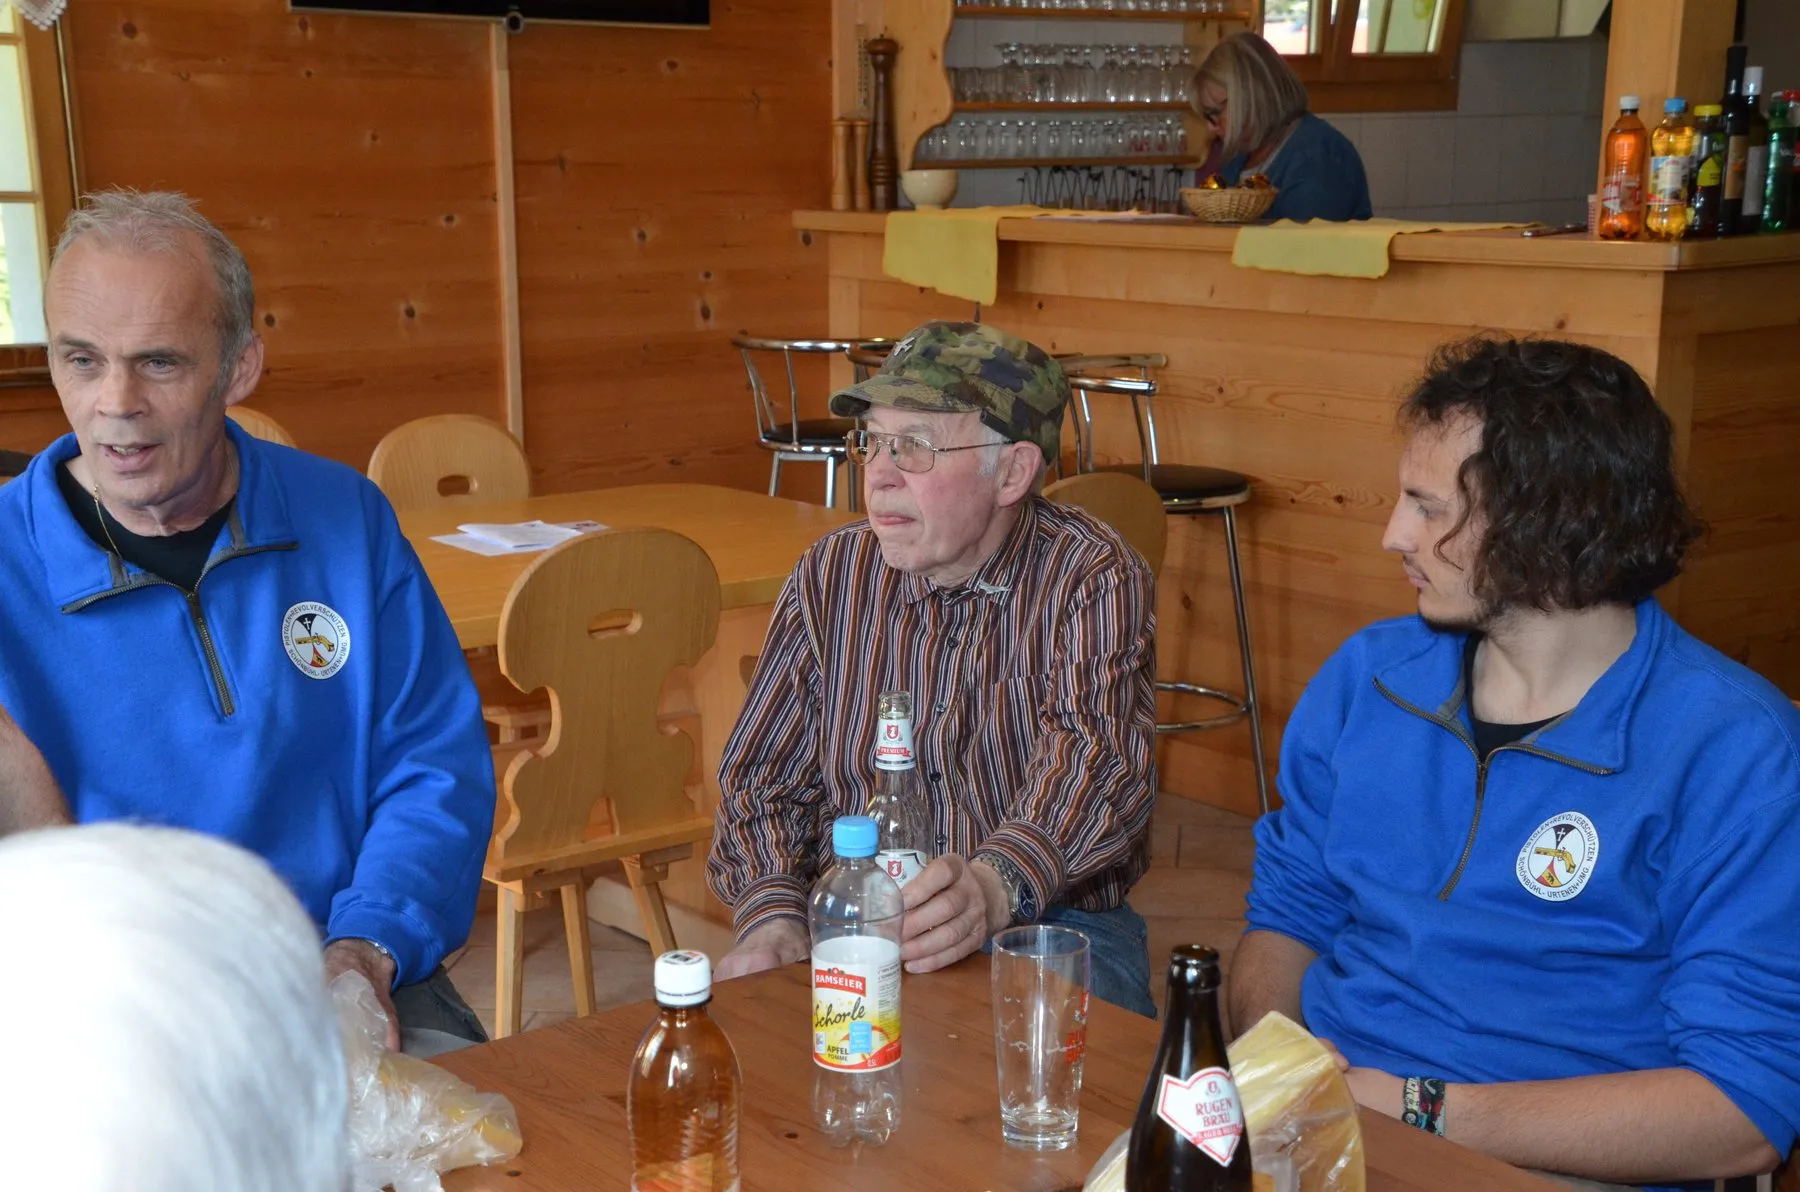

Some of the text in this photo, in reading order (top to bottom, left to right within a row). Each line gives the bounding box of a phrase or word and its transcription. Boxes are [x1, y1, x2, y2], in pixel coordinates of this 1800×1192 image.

[815, 974, 864, 991] RAMSEIER
[815, 996, 866, 1028] Schorle
[827, 1045, 849, 1055] APFEL
[1195, 1096, 1233, 1116] RUGEN
